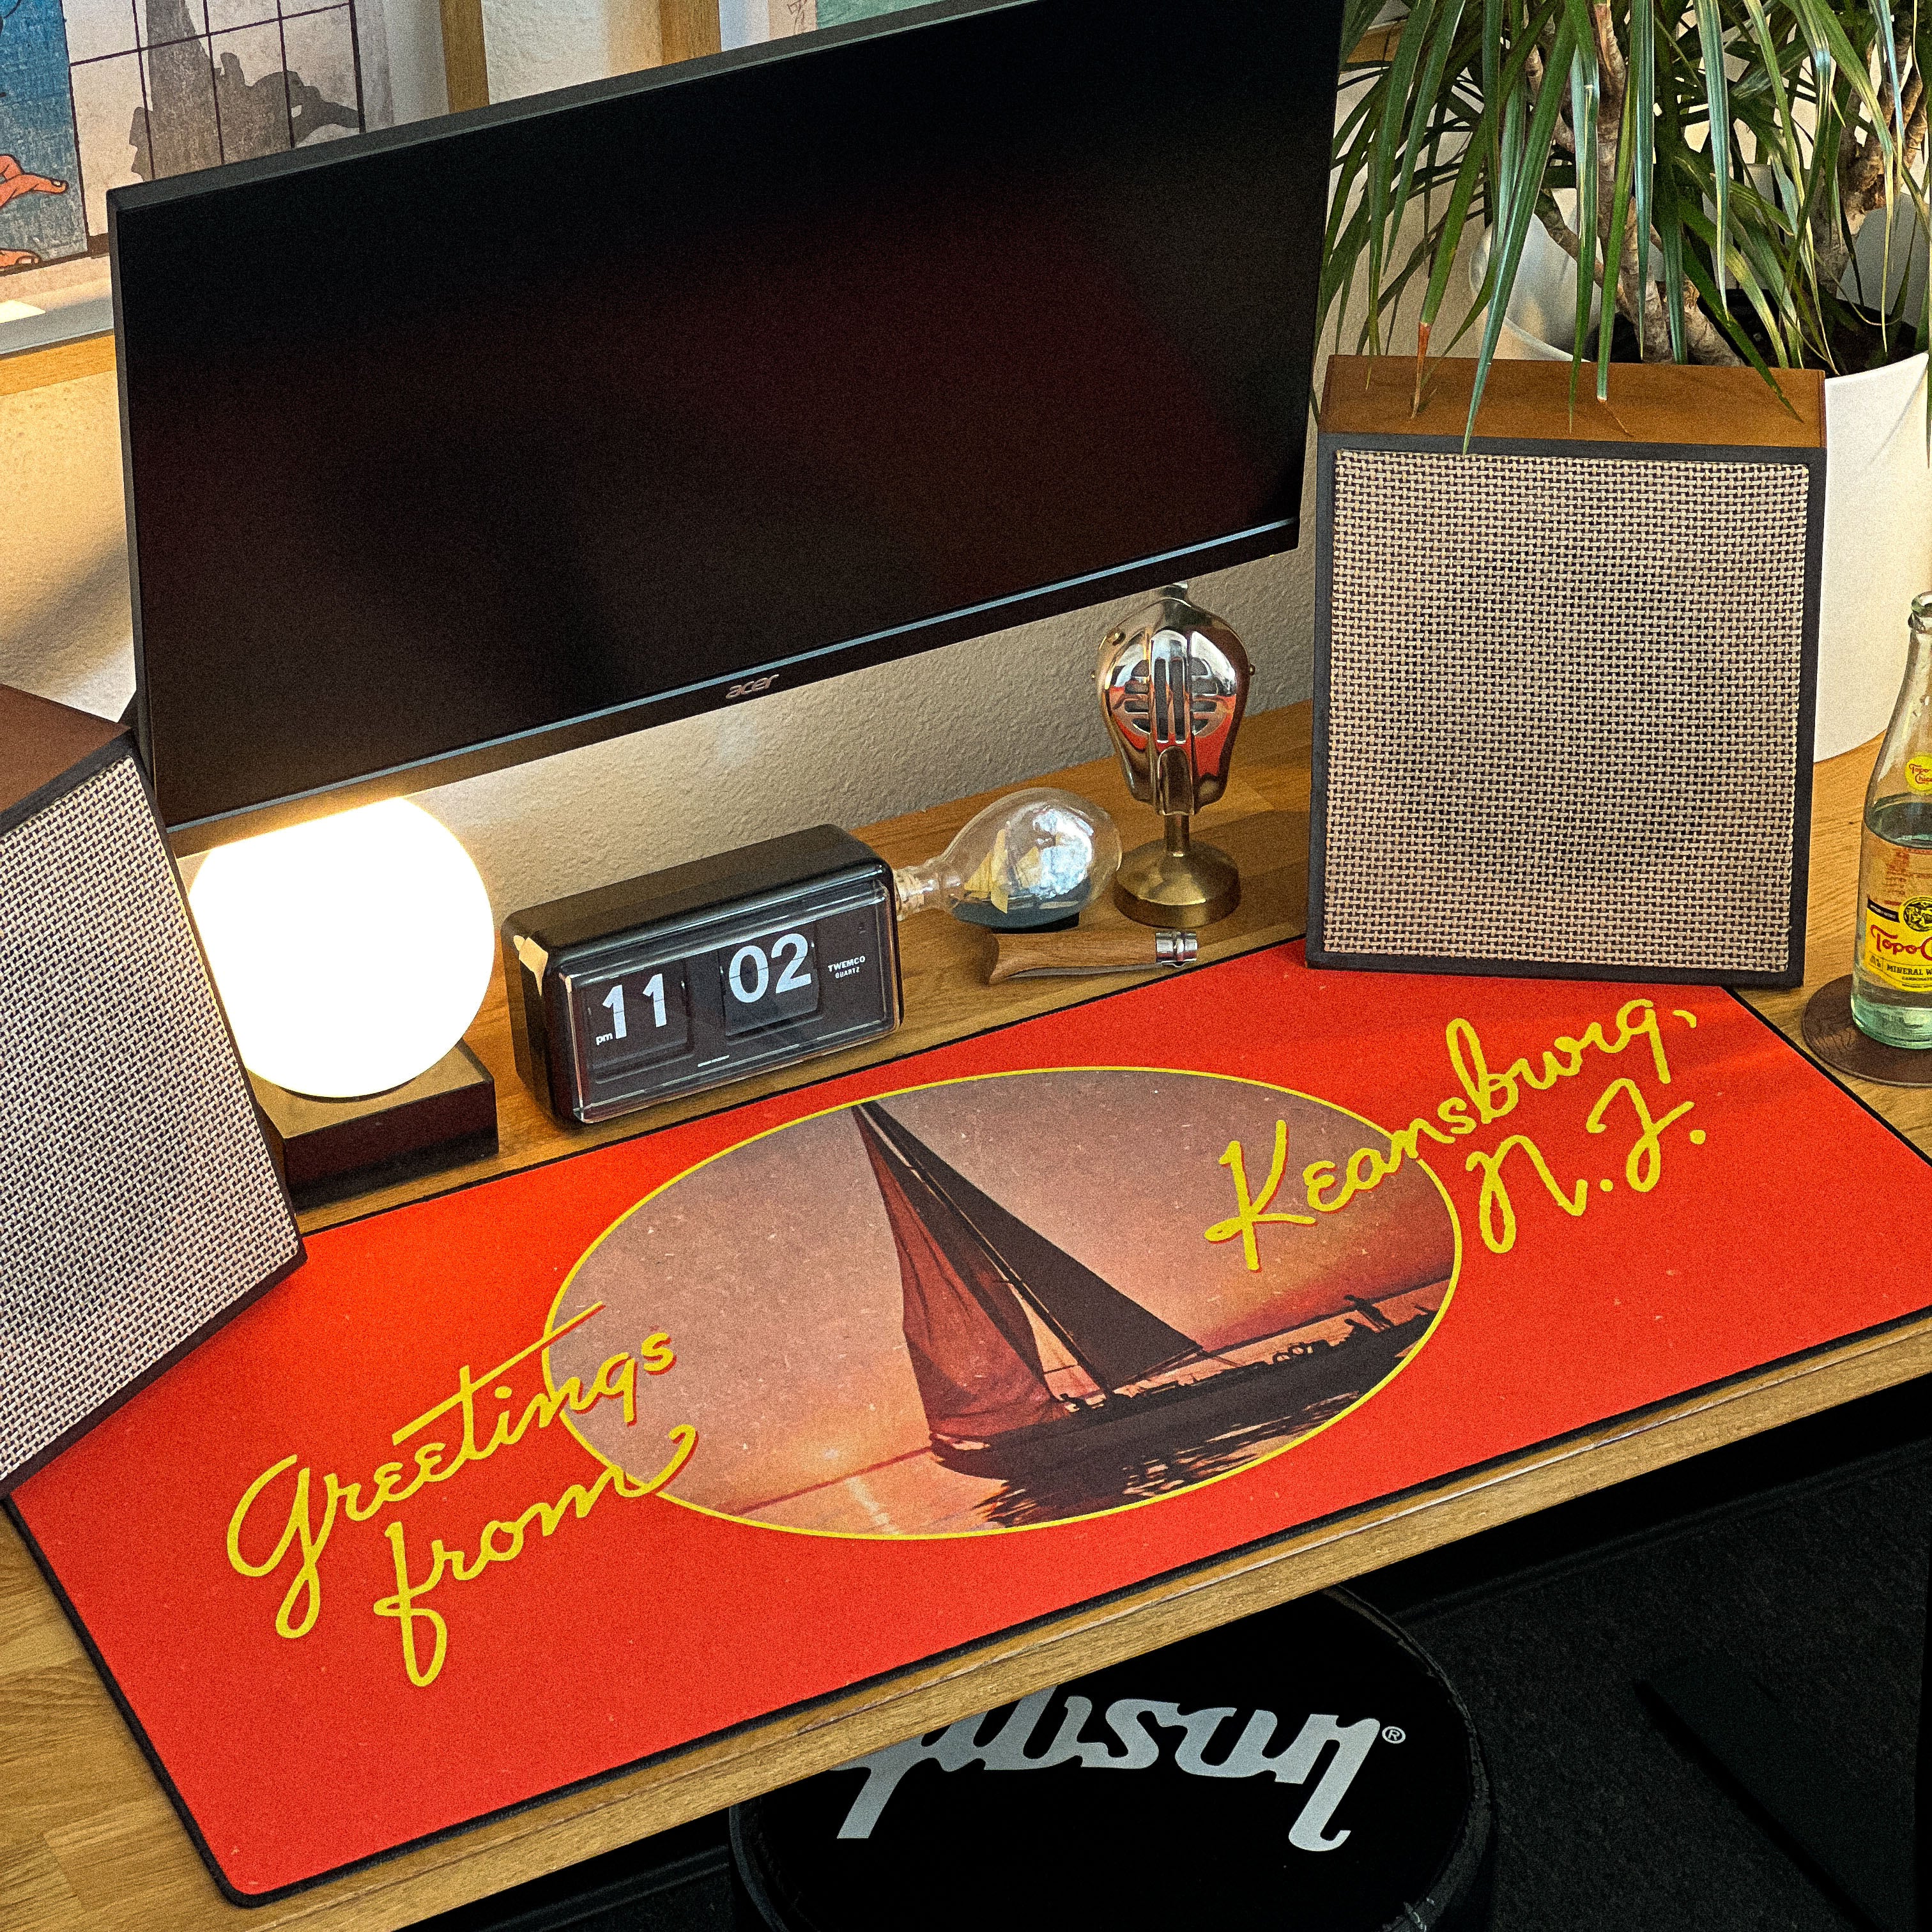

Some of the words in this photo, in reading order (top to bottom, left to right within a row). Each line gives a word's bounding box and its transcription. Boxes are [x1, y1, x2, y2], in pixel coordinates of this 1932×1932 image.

[725, 673, 779, 700] acer
[1870, 924, 1917, 955] Topo
[827, 955, 866, 972] TWEMCO
[835, 966, 860, 979] QUARTZ
[1886, 964, 1924, 976] MINERAL
[602, 973, 667, 1039] 11
[729, 933, 812, 1002] 02
[595, 1032, 613, 1046] pm
[227, 1301, 675, 1639] Greetings
[373, 1424, 700, 1687] from
